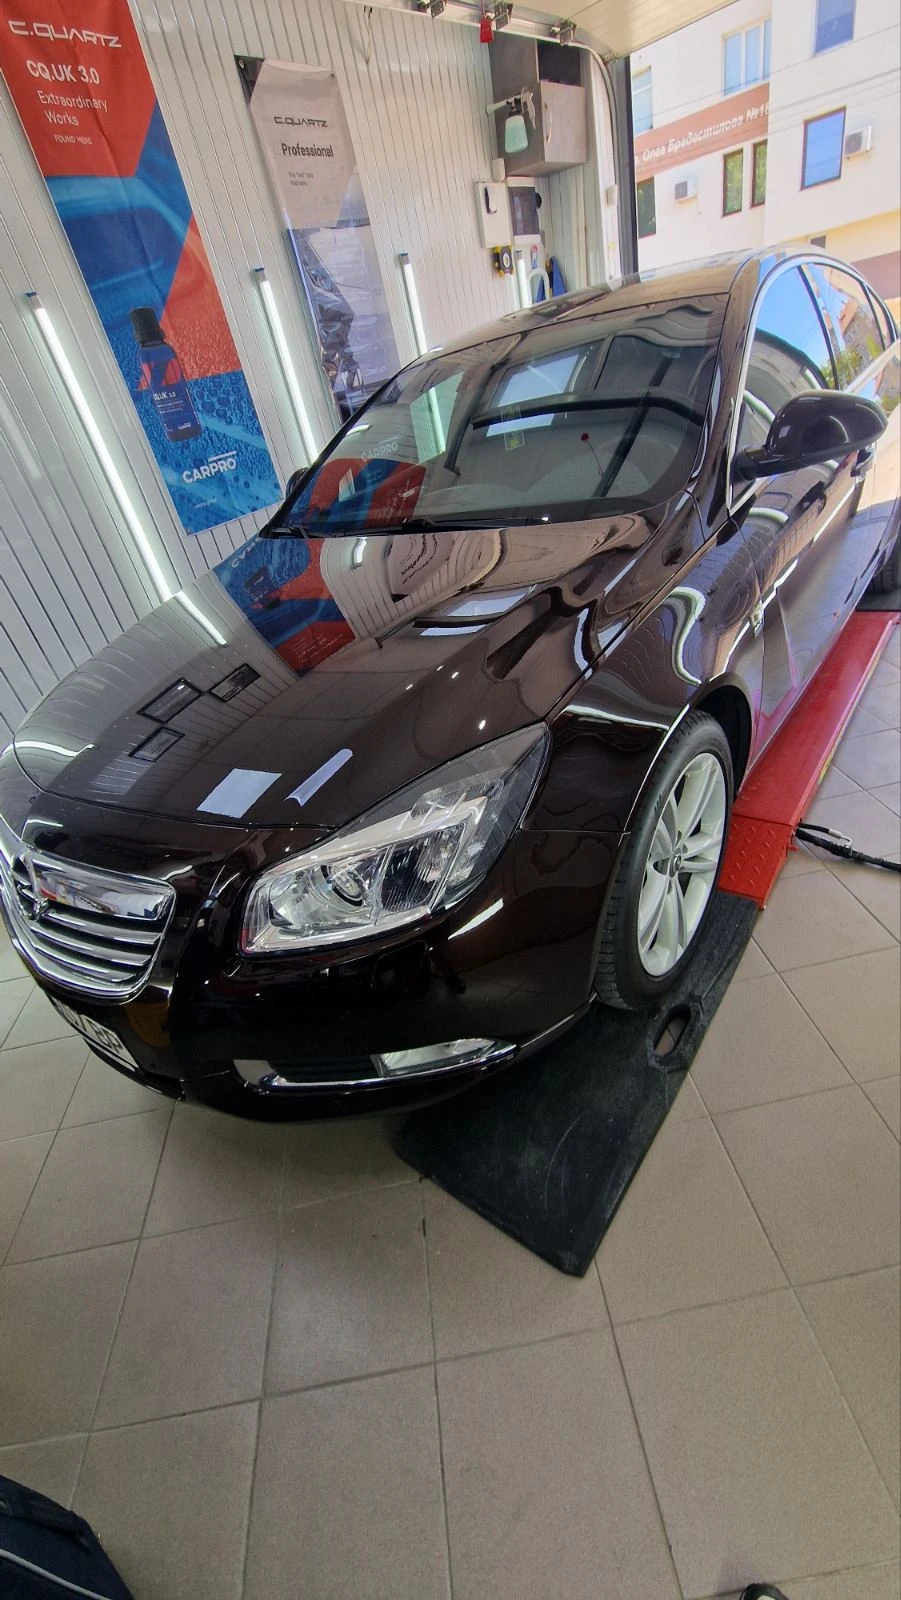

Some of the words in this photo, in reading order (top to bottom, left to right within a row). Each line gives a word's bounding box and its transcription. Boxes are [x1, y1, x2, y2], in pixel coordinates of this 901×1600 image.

[8, 20, 122, 48] C.QUARTZ
[26, 60, 77, 82] CQ.UK
[78, 66, 100, 85] 3.0
[37, 90, 108, 112] Extraordinary
[44, 110, 79, 126] Works
[274, 116, 328, 128] C.QUARTZ
[53, 134, 76, 143] FOUND
[281, 143, 334, 157] Professional
[361, 441, 398, 462] CARPRO
[183, 457, 237, 483] CARPRO
